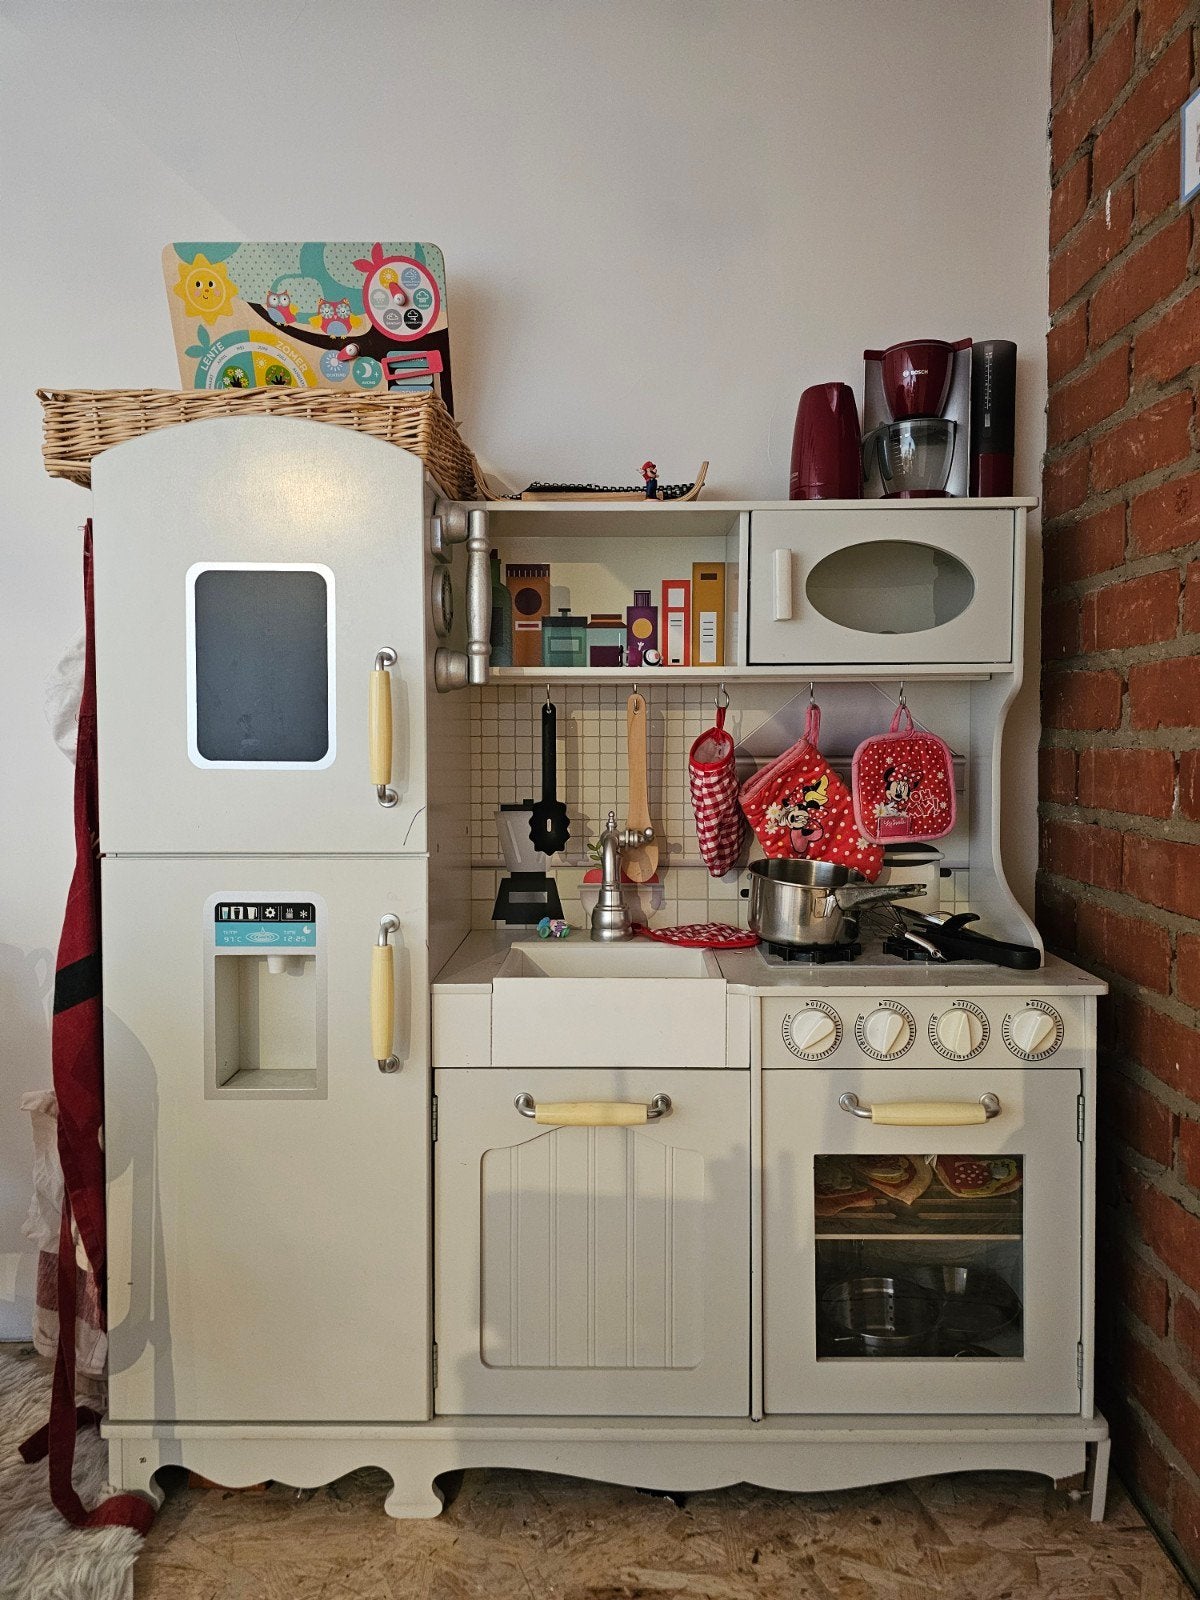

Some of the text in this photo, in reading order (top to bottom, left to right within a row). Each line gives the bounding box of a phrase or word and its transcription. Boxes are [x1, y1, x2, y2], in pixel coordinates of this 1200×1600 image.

[200, 341, 225, 371] LENTE
[275, 340, 308, 373] ZOMER
[905, 797, 940, 817] MY!
[909, 789, 932, 802] OH
